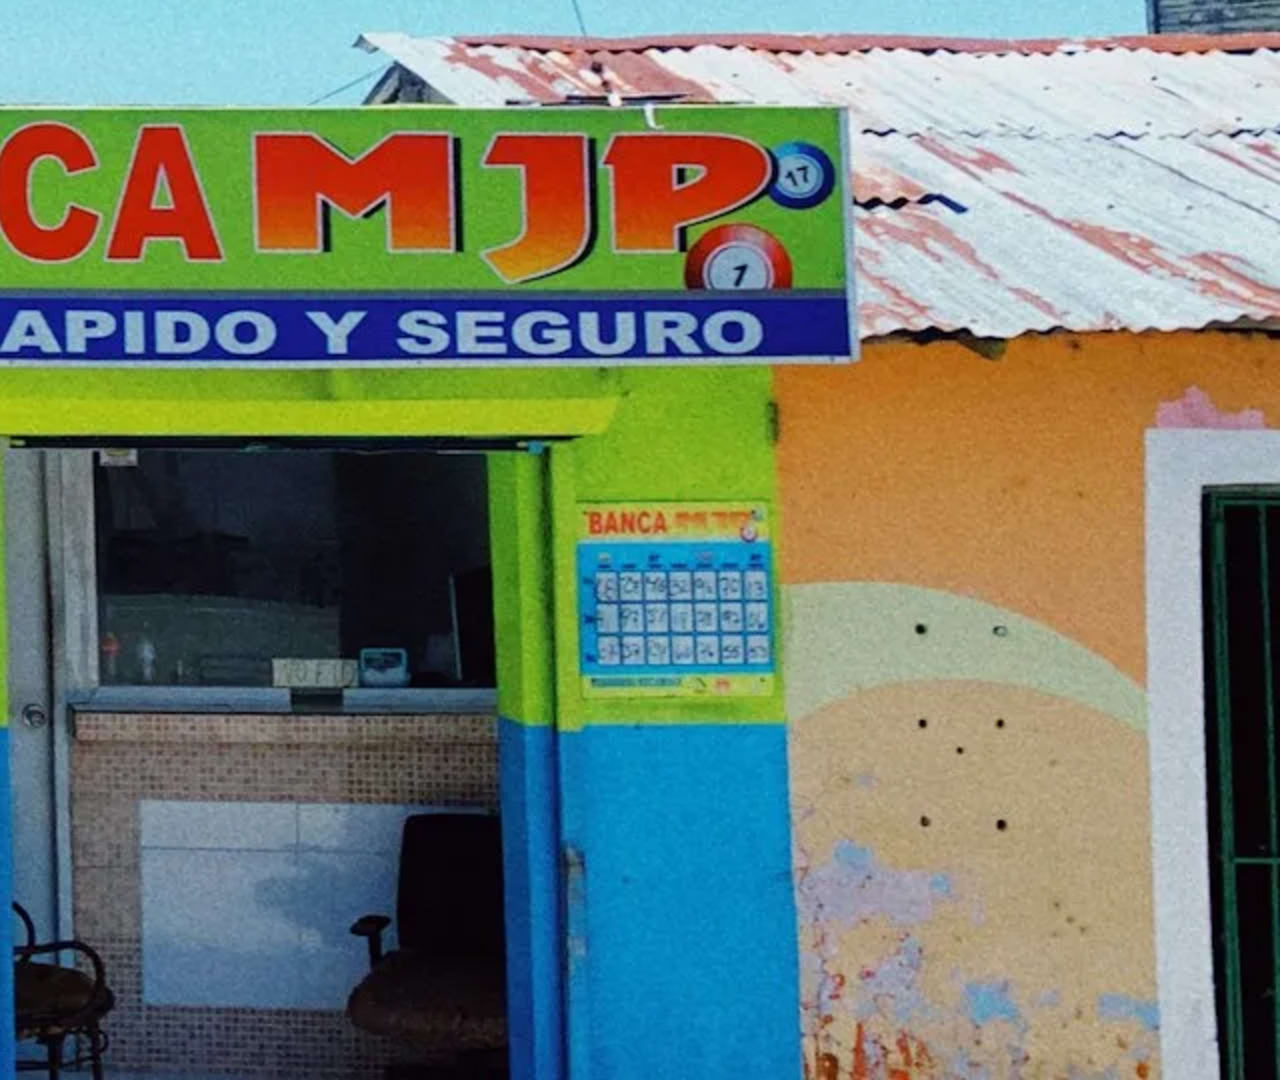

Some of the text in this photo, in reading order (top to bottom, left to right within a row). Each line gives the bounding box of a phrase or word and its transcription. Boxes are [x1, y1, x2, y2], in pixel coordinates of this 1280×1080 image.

[785, 166, 809, 187] 17
[253, 131, 774, 284] MJP
[306, 311, 368, 353] Y
[396, 309, 764, 355] SEGURO
[589, 511, 668, 535] BANCA
